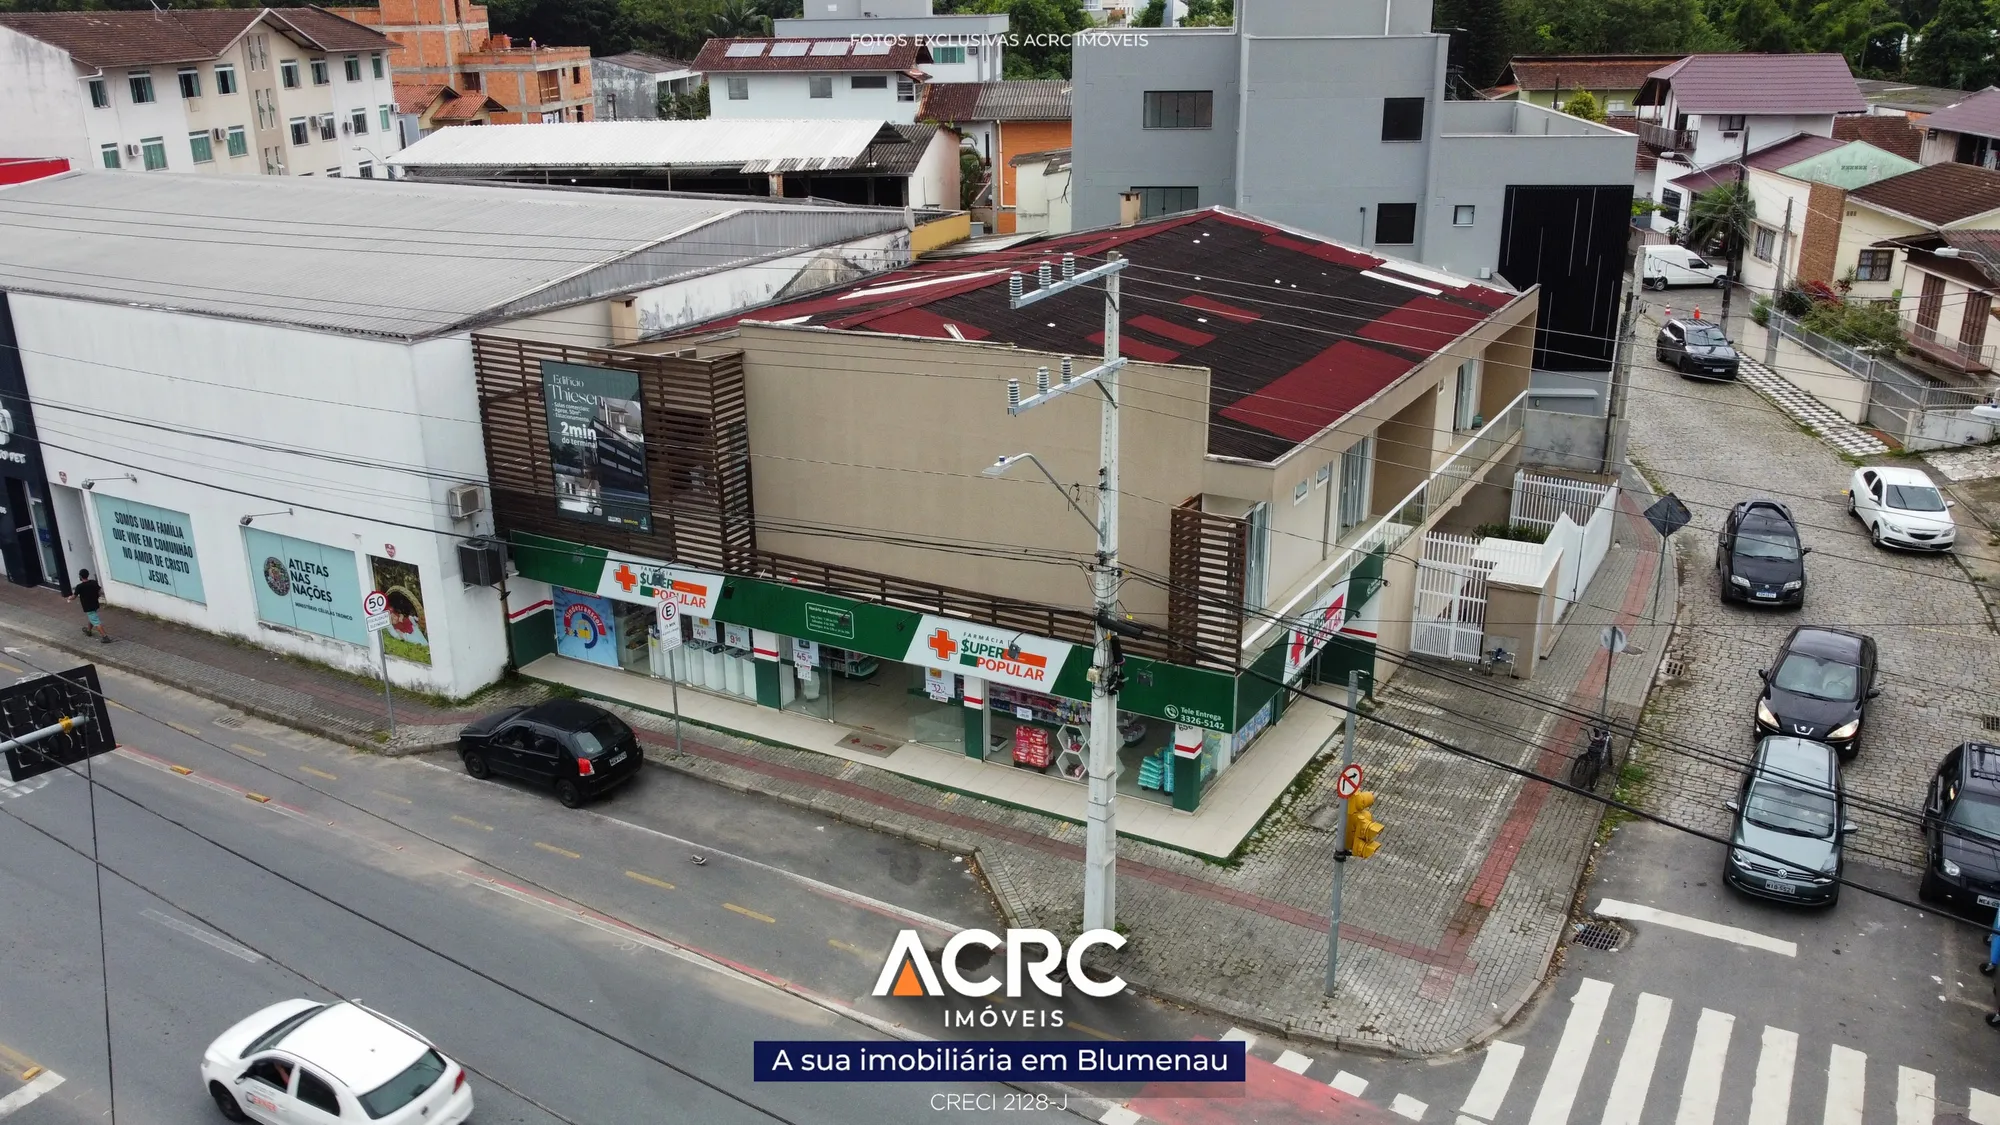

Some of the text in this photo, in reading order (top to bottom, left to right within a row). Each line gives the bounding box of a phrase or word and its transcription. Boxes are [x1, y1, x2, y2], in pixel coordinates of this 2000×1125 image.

[548, 384, 604, 406] Thiesen
[560, 421, 597, 440] 2min
[571, 438, 598, 449] terminal
[114, 511, 184, 539] SOMOS UMA FAMÍLIA
[112, 527, 194, 558] QUE VIVE EM COMUNHÃO
[122, 546, 190, 574] NO AMOR DE CRISTO
[289, 558, 329, 577] ATLETAS
[290, 570, 311, 585] NAS
[292, 582, 333, 602] NAÇÕES
[368, 596, 384, 609] 50
[665, 605, 673, 617] E
[963, 631, 1004, 645] FARMÁCIA
[976, 657, 1044, 681] POPULAR
[1180, 714, 1224, 730] 3326-5142
[1181, 707, 1221, 721] Tele Entrega
